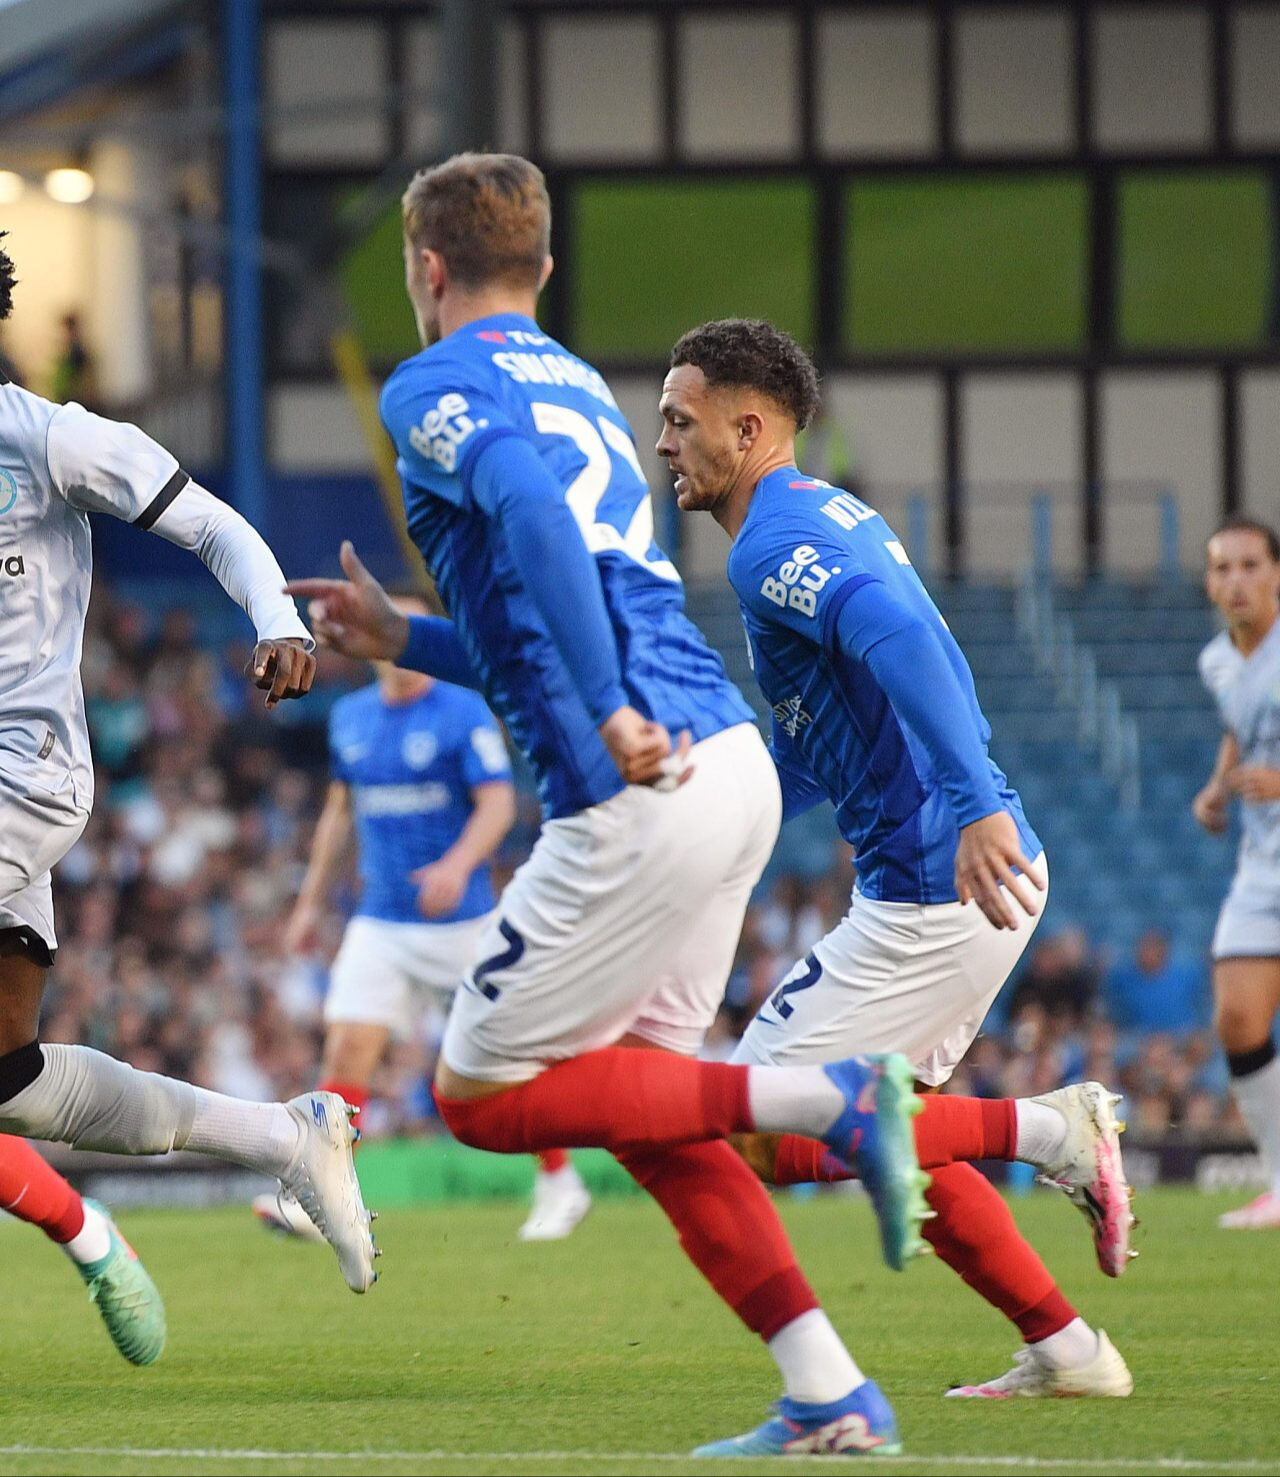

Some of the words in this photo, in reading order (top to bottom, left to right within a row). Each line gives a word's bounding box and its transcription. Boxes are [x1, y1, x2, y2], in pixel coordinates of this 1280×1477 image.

[409, 392, 470, 459] Bee
[530, 401, 682, 584] 22
[760, 545, 821, 608] Bee
